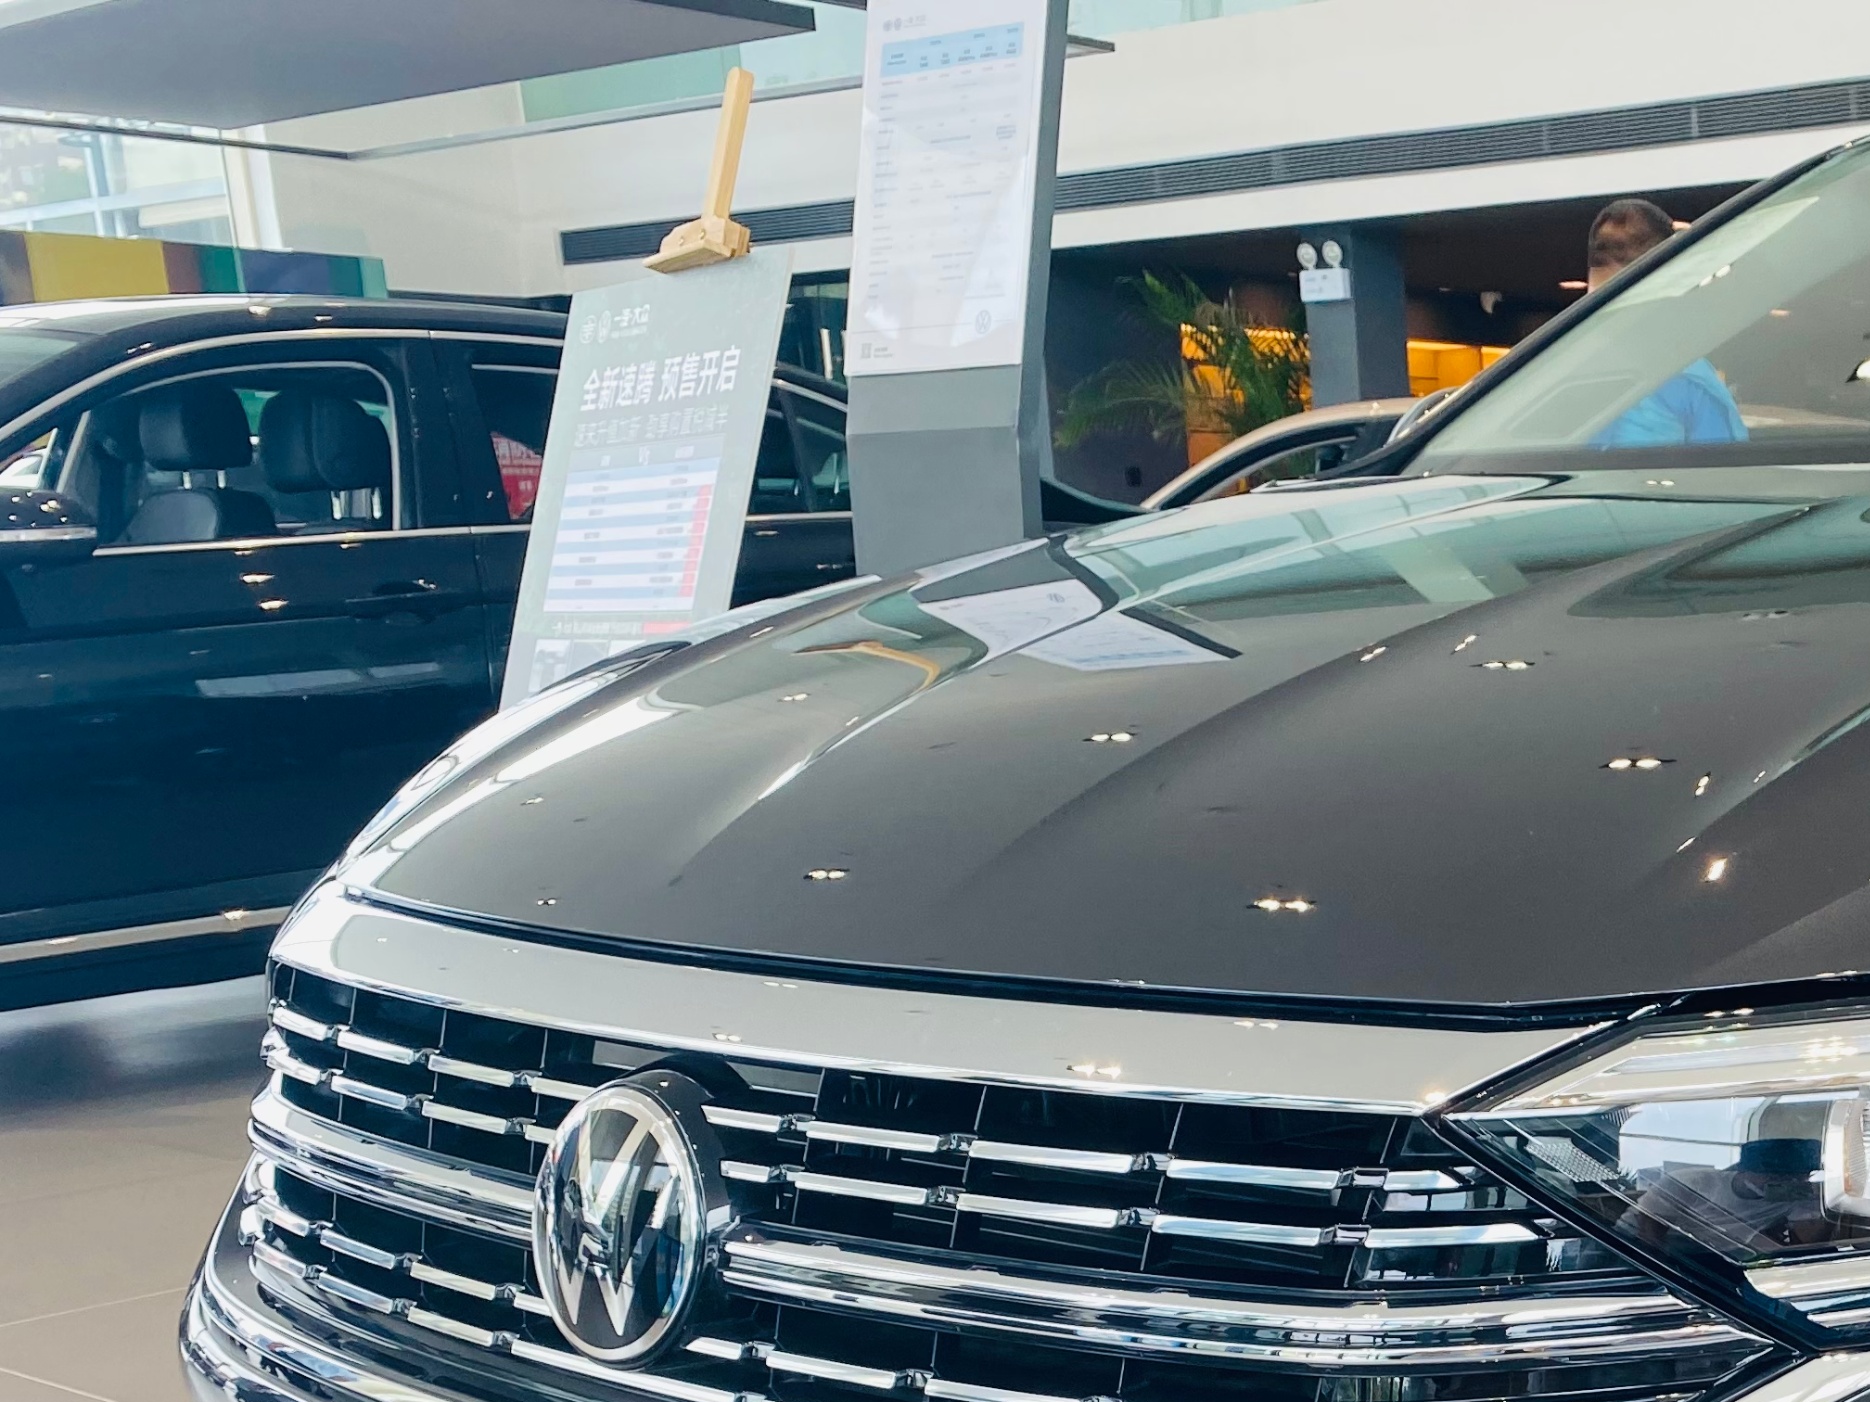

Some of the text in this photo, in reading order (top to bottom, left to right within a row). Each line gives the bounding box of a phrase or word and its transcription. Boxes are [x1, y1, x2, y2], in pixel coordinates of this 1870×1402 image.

[580, 345, 742, 412] 全新速腾 预售开启
